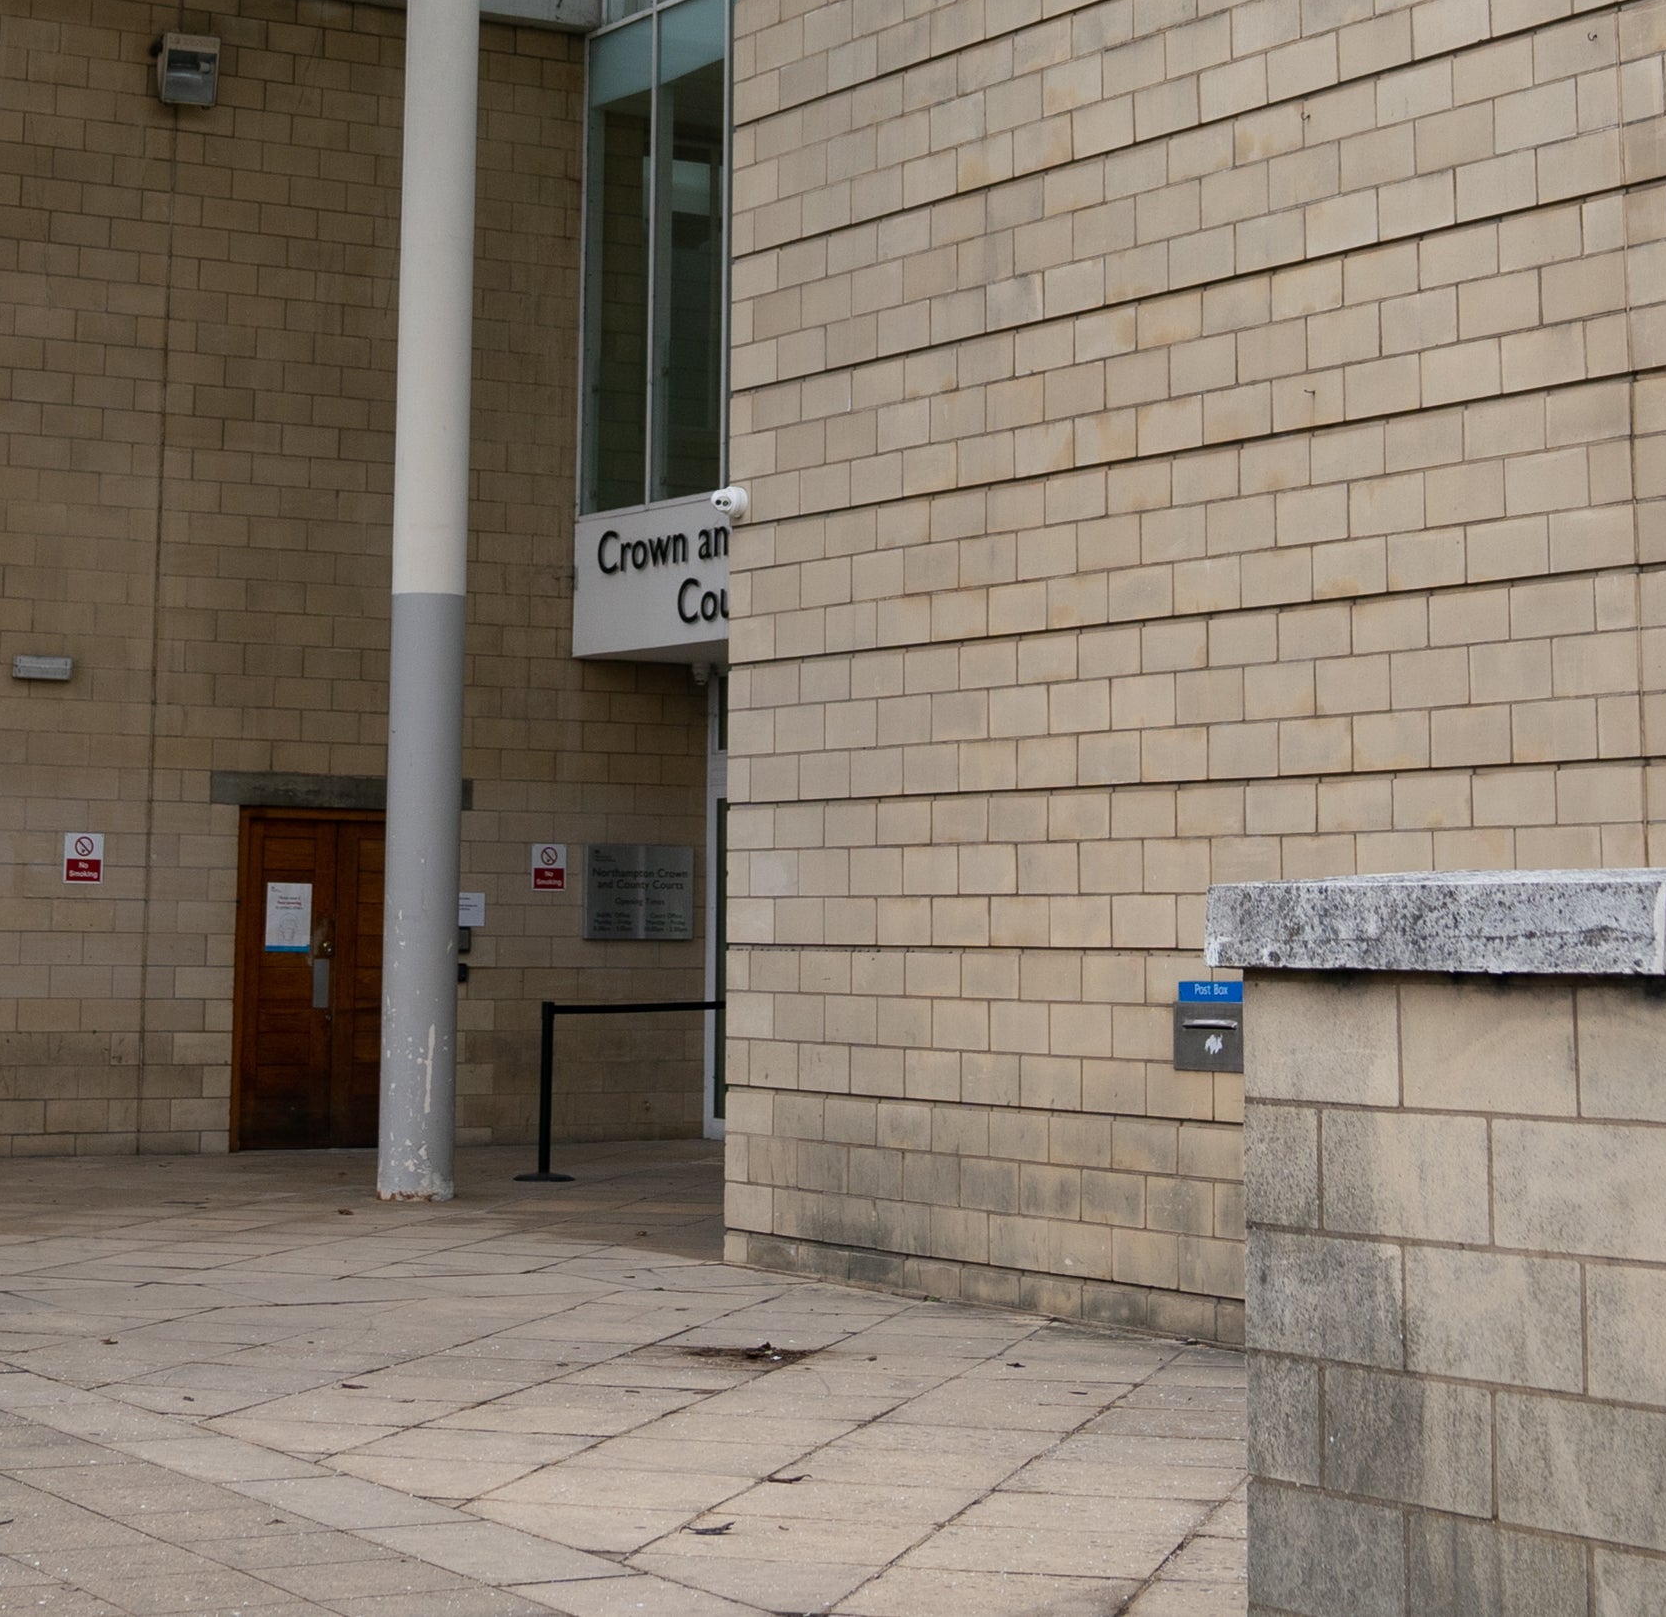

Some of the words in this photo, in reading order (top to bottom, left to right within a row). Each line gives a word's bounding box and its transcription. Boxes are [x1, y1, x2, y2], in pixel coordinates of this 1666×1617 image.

[597, 529, 689, 575] Crown
[78, 861, 89, 869] No
[68, 870, 99, 879] Smoking
[544, 870, 554, 878] No
[591, 867, 655, 879] Northampton
[657, 868, 688, 878] Crown
[536, 878, 563, 887] Smoking
[597, 879, 613, 888] and
[616, 879, 649, 890] County
[653, 880, 684, 889] Courts
[1194, 983, 1211, 995] Post
[1213, 983, 1229, 995] Box
